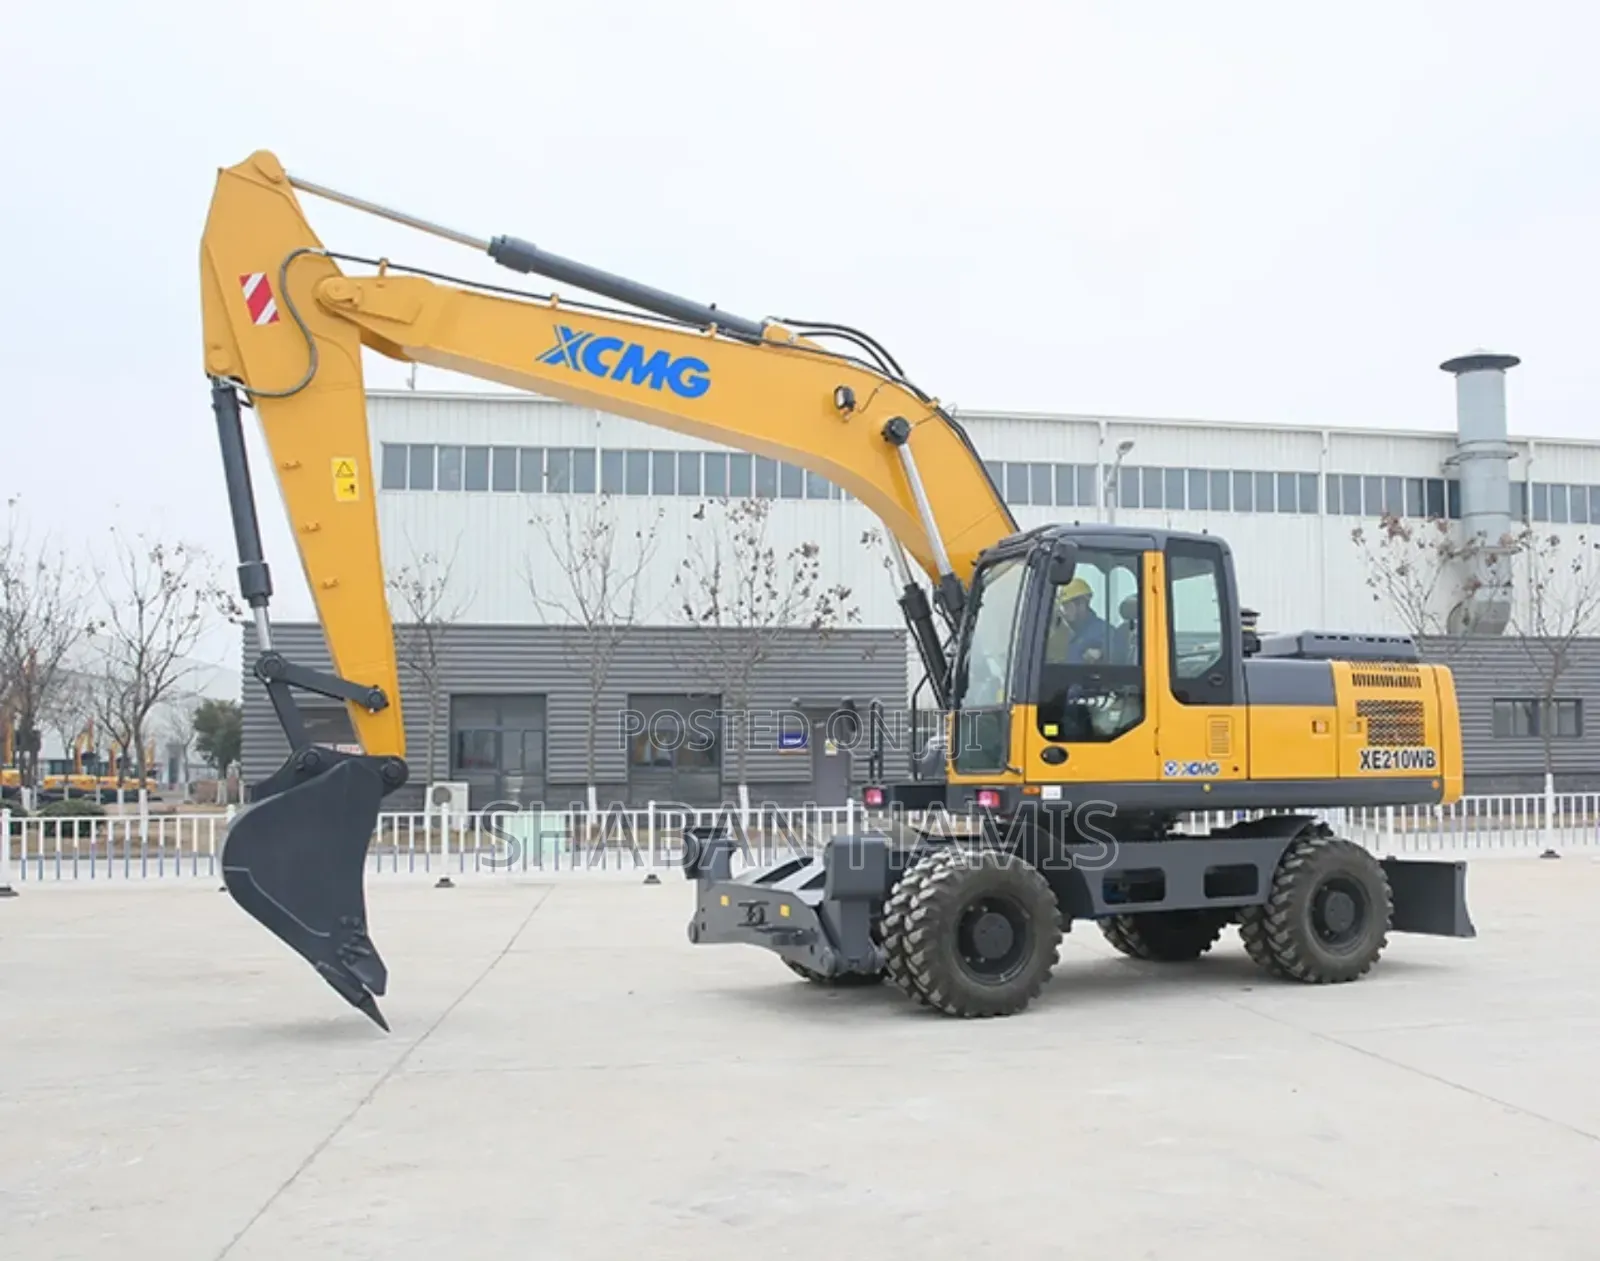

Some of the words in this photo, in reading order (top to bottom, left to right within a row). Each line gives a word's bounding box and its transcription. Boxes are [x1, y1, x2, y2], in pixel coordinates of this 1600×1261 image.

[535, 324, 711, 398] XCMG
[1181, 761, 1219, 776] XCMG
[1360, 749, 1436, 769] XE210WB
